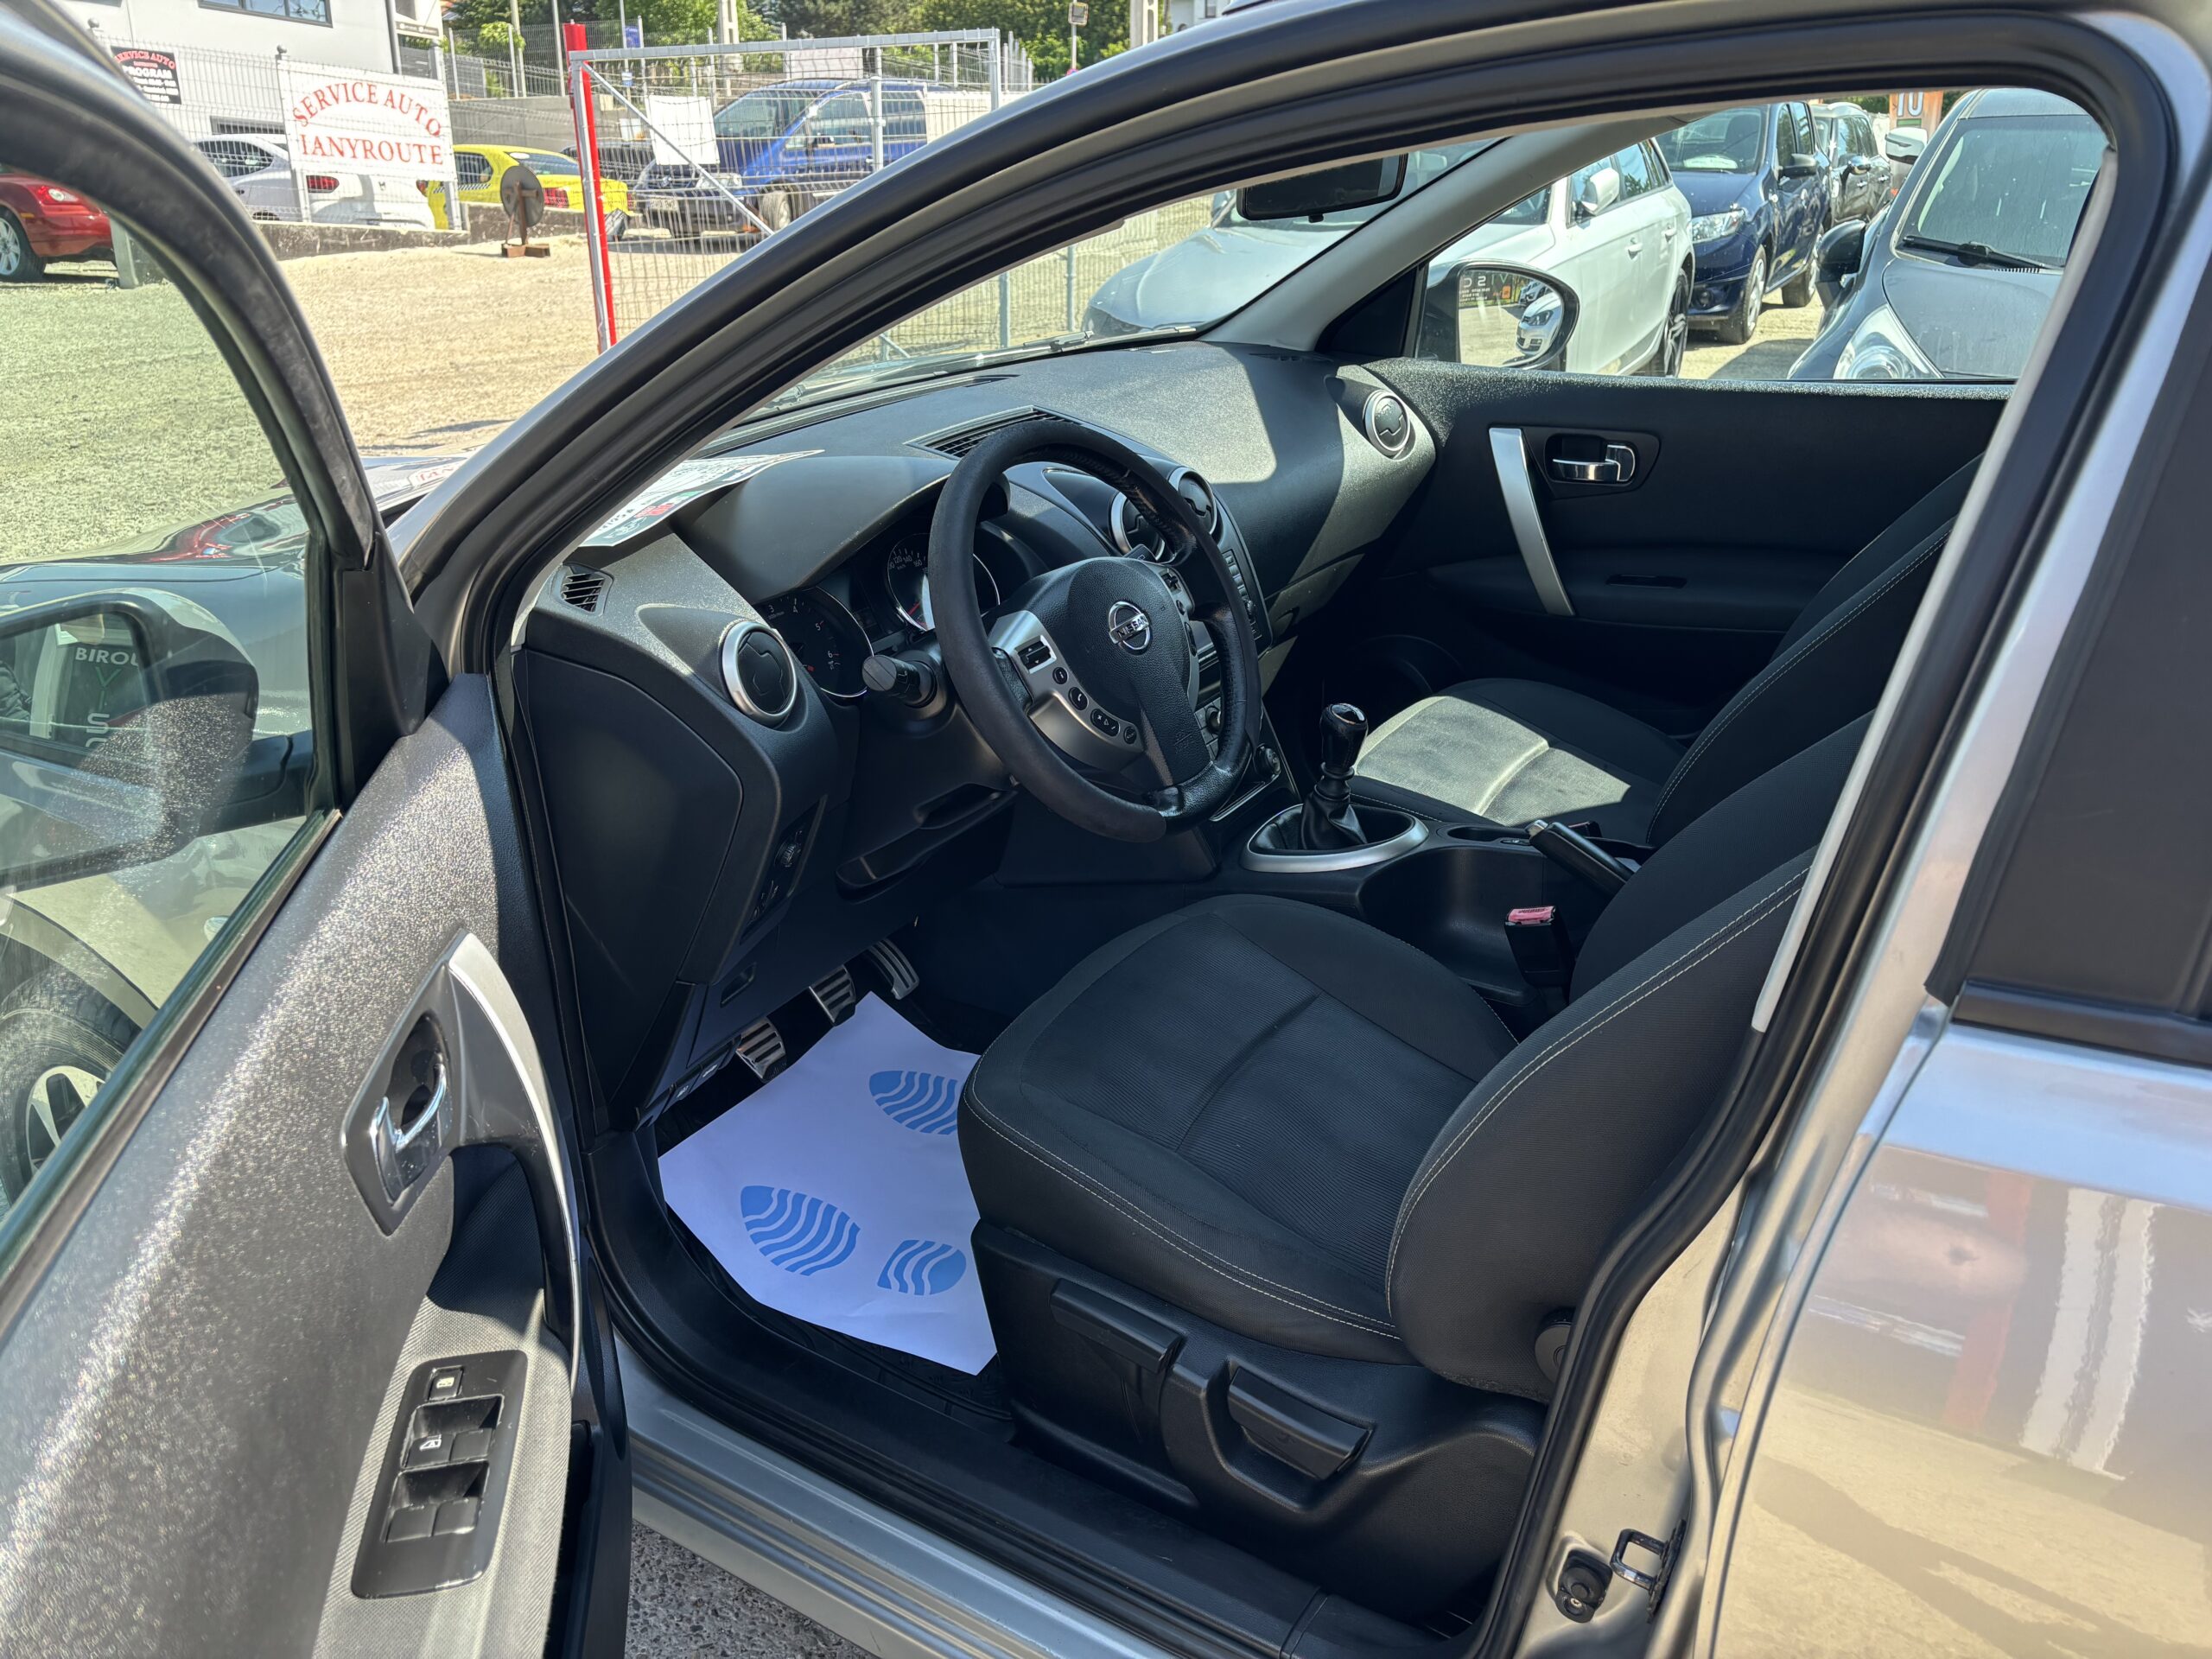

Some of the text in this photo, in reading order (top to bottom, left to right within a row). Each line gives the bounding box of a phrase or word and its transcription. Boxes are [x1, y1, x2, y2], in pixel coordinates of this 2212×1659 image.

[292, 81, 442, 137] SERVICE AUTO
[299, 134, 443, 165] IANYROUTE
[1116, 615, 1147, 639] NISSAN
